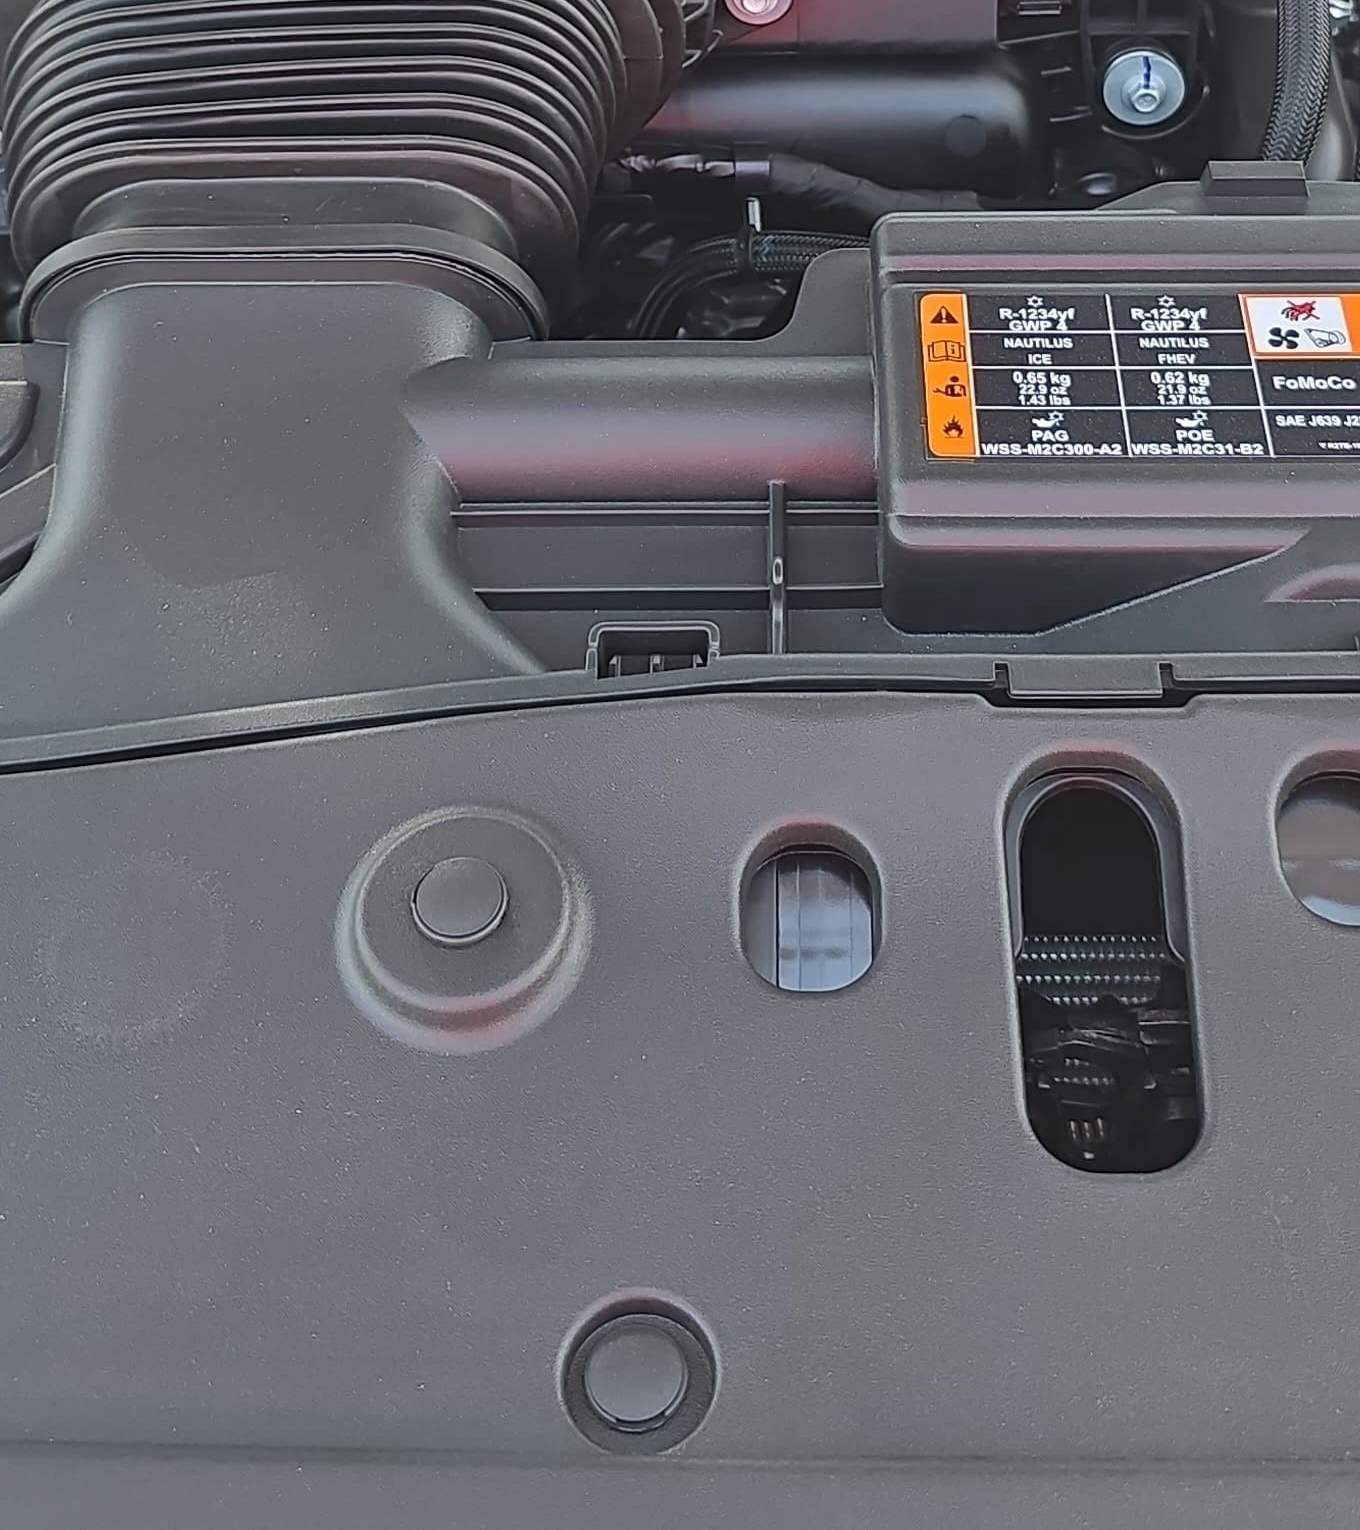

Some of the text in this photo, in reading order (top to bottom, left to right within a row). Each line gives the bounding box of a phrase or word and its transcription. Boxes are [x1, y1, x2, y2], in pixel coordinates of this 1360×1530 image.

[999, 307, 1076, 322] R-1234yf
[1130, 307, 1208, 322] R-1234yf
[1009, 320, 1068, 331] GWP 4
[1141, 320, 1201, 331] GWP 4
[1004, 338, 1073, 348] NAUTILUS
[1139, 337, 1210, 348] NAUTILUS
[1028, 354, 1052, 365] ICE
[1158, 353, 1196, 364] FHEV
[1013, 371, 1071, 387] 0.65 kg
[1151, 371, 1210, 386] 0.62 kg
[1272, 376, 1357, 390] FoMoCo
[1019, 384, 1068, 395] 22.9 oz
[1157, 384, 1207, 395] 21.9 oz
[1018, 395, 1071, 406] 1.43 lbs
[1157, 395, 1211, 406] 1.37 lbs
[1275, 415, 1308, 427] SAE
[1308, 415, 1342, 427] J639
[1032, 430, 1070, 441] PAG
[1176, 429, 1215, 441] POE
[980, 443, 1123, 455] WSS-M2C300-A2
[1131, 443, 1265, 455] WSS-M2C31-B2
